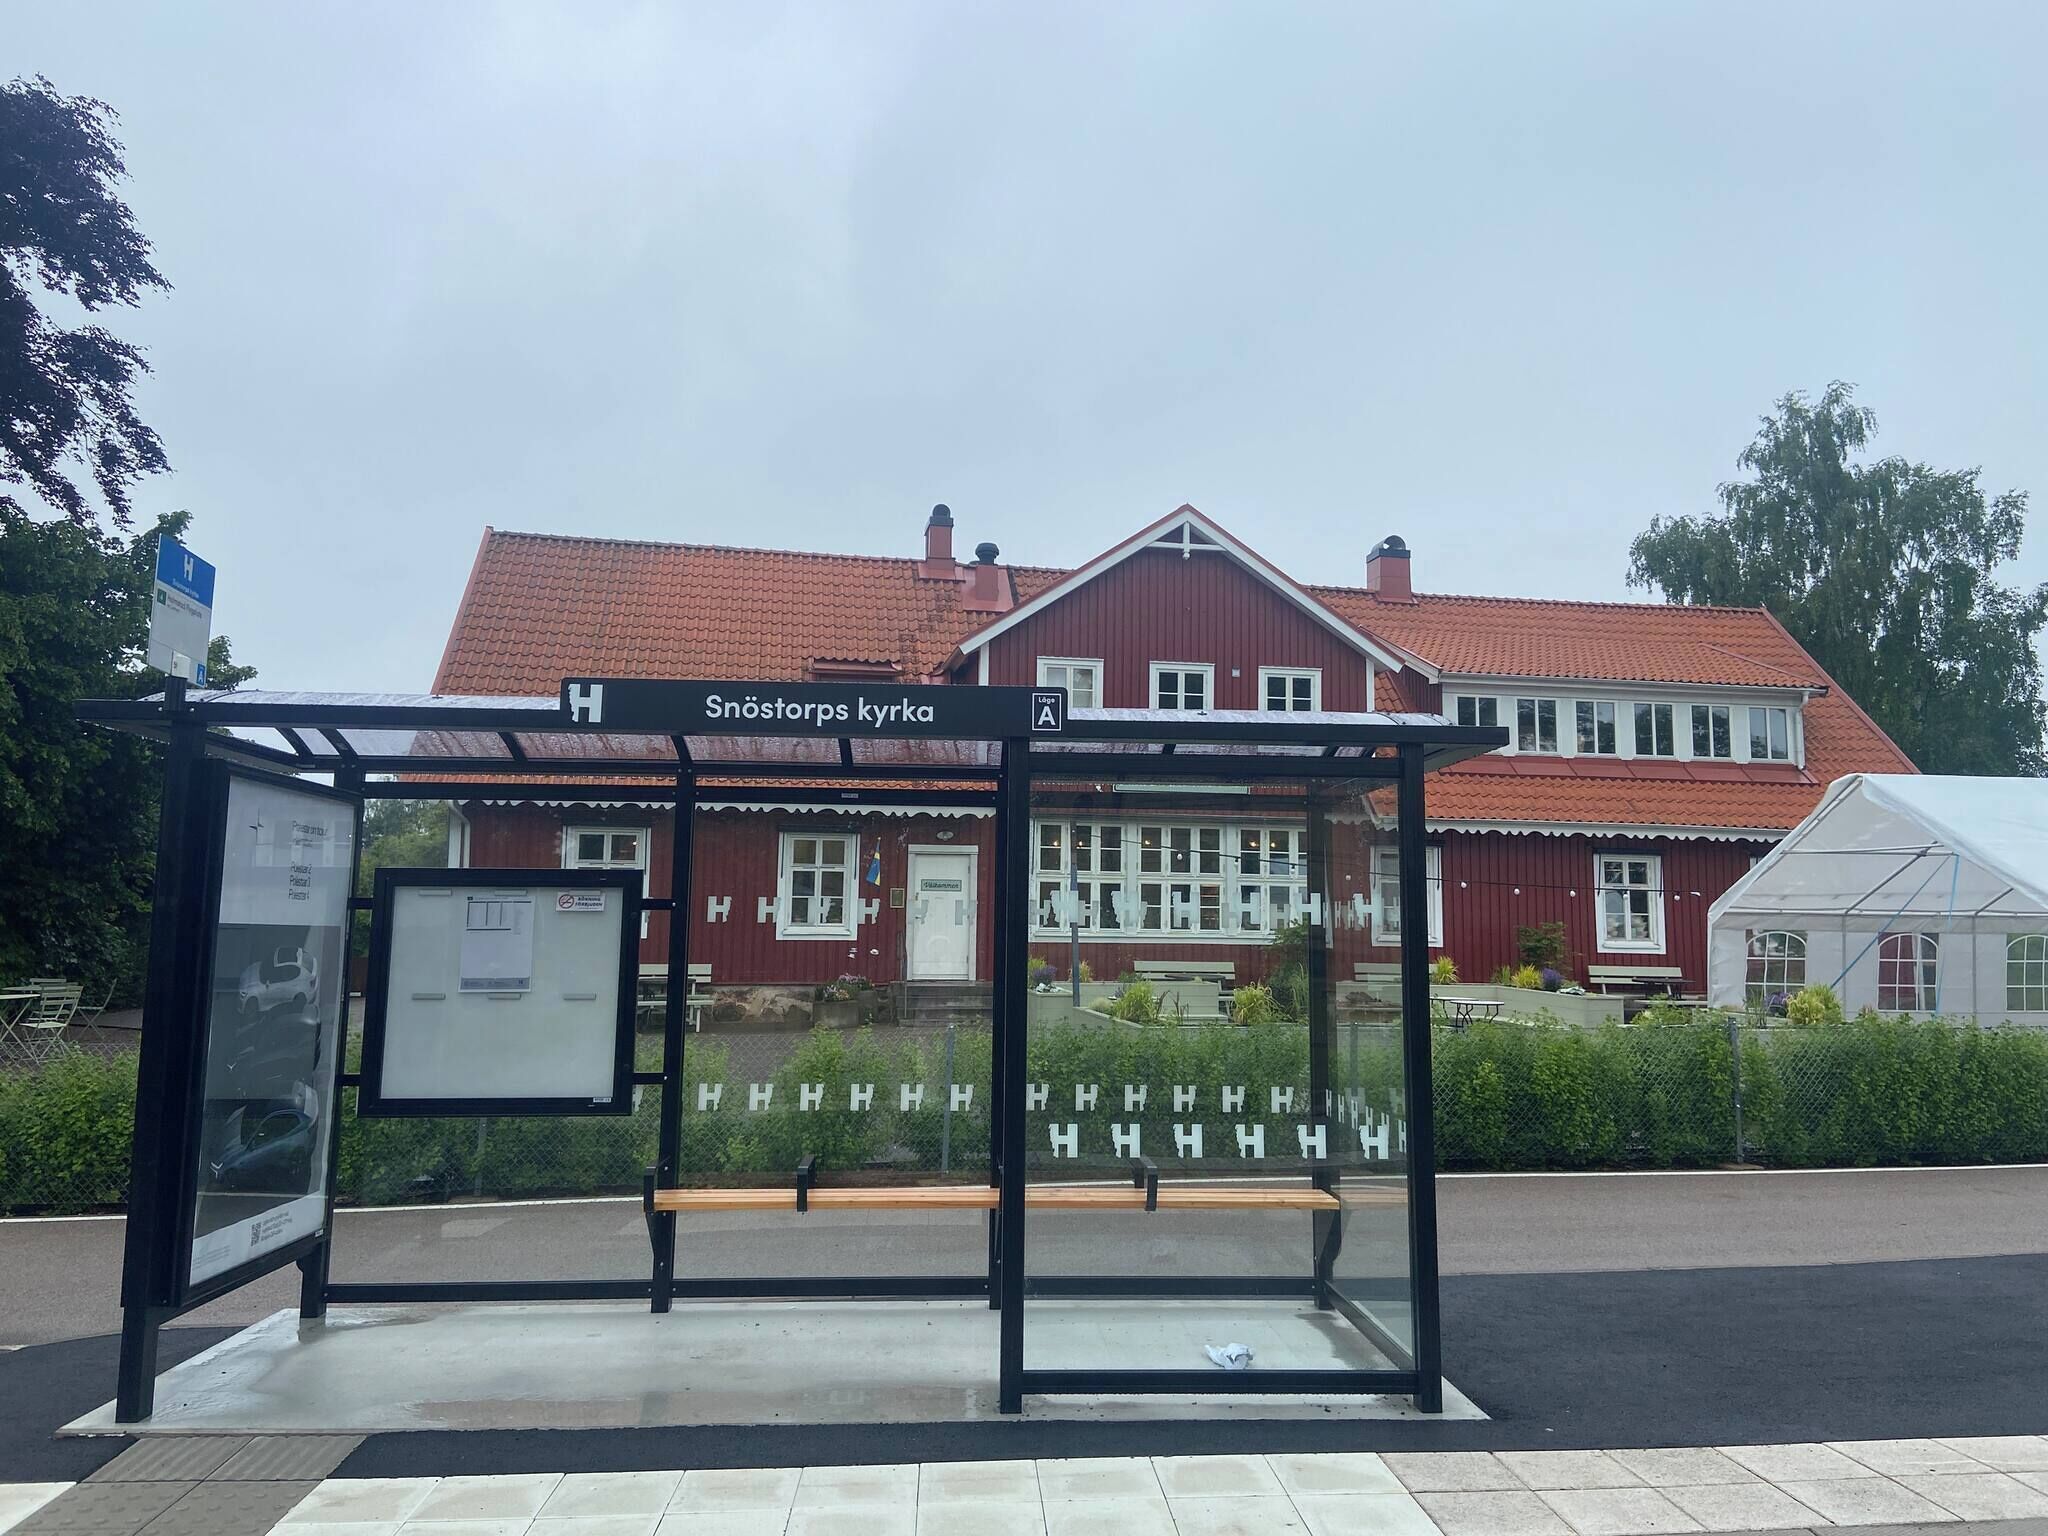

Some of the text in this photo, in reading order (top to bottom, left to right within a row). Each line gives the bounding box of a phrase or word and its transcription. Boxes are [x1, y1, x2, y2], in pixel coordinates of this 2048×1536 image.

[568, 683, 603, 723] H
[706, 694, 934, 728] Snöstorps kyrka
[1037, 705, 1056, 726] A
